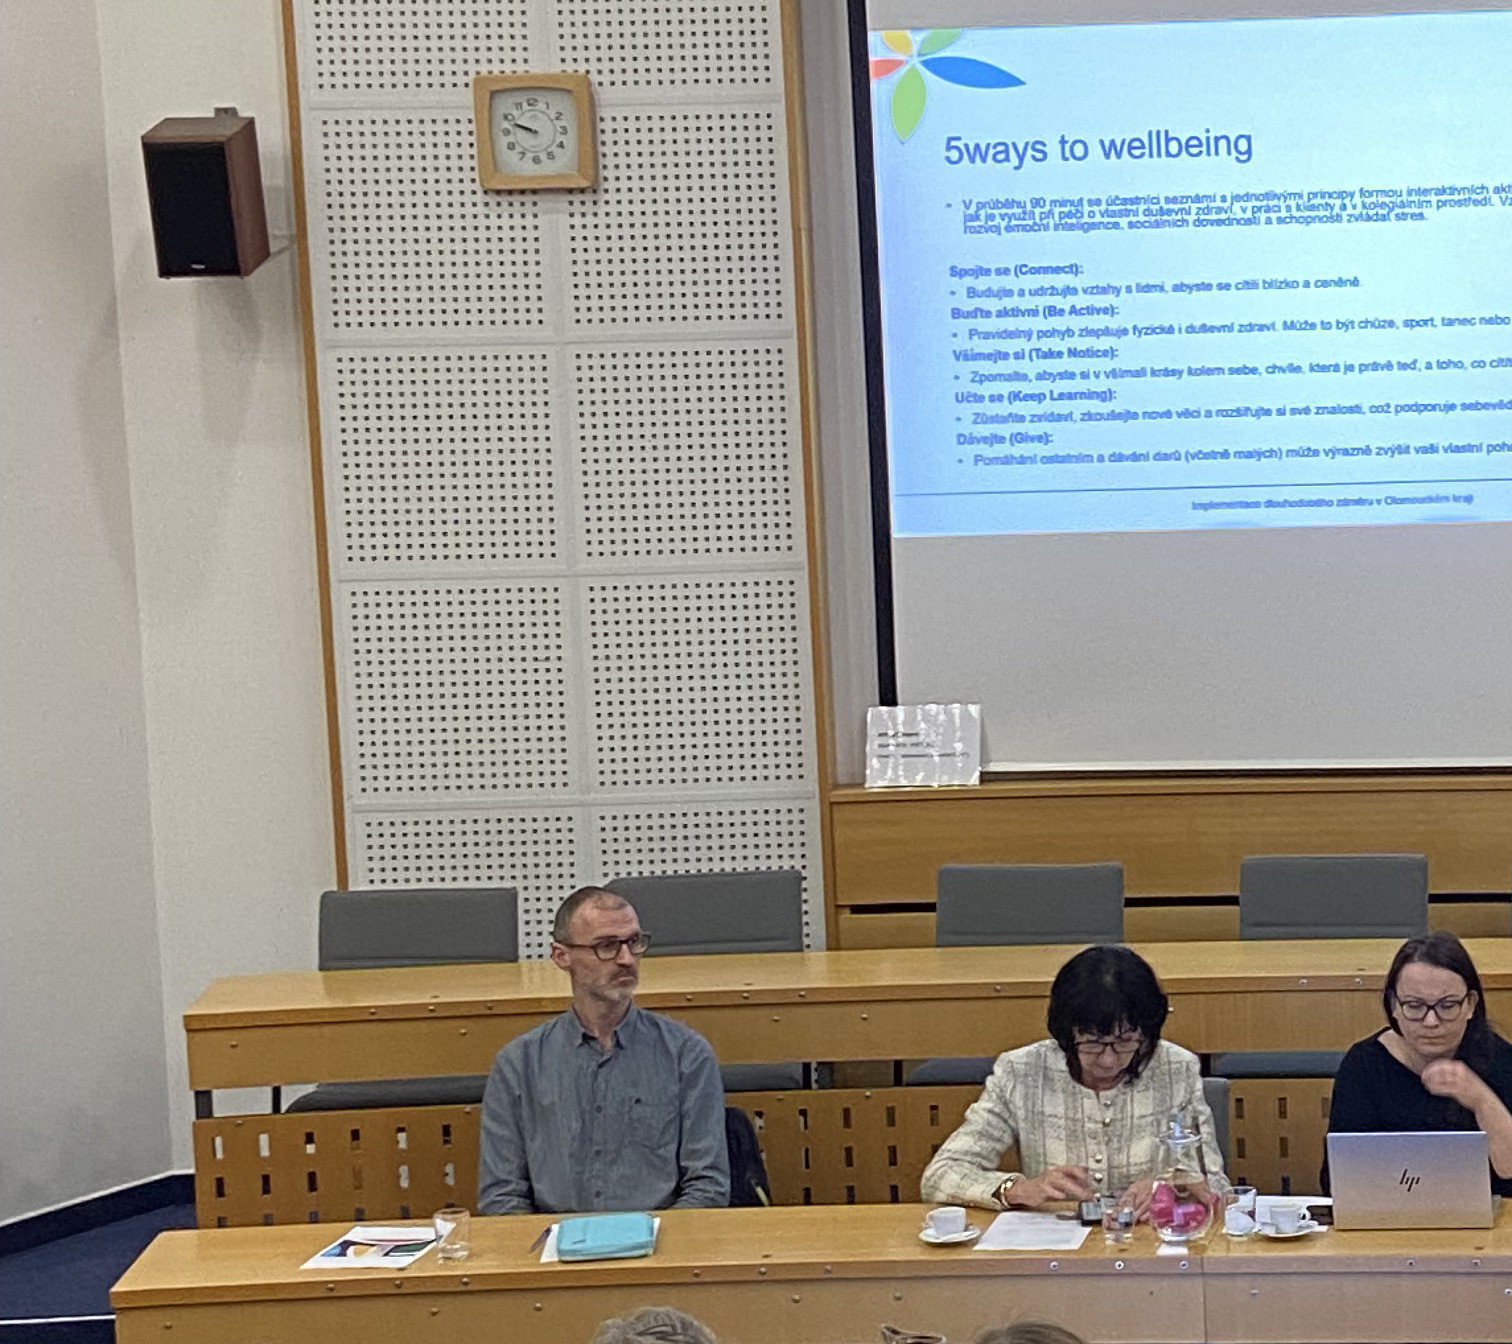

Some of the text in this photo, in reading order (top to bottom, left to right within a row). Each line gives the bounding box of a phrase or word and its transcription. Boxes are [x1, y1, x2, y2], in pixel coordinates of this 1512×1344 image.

[944, 128, 1253, 171] 5ways to wellbeing
[1030, 197, 1044, 207] 90
[1049, 196, 1084, 207] minut
[1087, 198, 1101, 206] se
[1307, 188, 1355, 202] principy
[1359, 187, 1402, 198] formou
[964, 210, 980, 224] jak
[984, 210, 996, 223] je
[1295, 200, 1335, 214] klienty
[964, 221, 1001, 235] rozvoj
[1394, 209, 1428, 220] stres.
[949, 263, 1084, 279] Spojte se (Connect):
[966, 287, 1014, 300] Budujte
[1081, 283, 1122, 297] vztahy
[1136, 282, 1168, 294] lidmi,
[1171, 281, 1212, 294] abyste
[1216, 283, 1231, 291] se
[1043, 305, 1065, 319] (Be
[1068, 304, 1119, 318] Active):
[1036, 327, 1075, 341] pohyb
[1320, 319, 1332, 330] to
[1441, 316, 1476, 327] tanec
[1479, 315, 1510, 325] nebo
[1013, 349, 1025, 359] si
[1029, 348, 1064, 362] (Take
[1067, 346, 1118, 361] Notice):
[970, 370, 1032, 385] Zpomalte,
[1035, 369, 1076, 383] abyste
[1080, 369, 1090, 379] si
[1187, 365, 1224, 376] kolem
[1227, 364, 1262, 376] sebe,
[1343, 361, 1355, 375] je
[1436, 359, 1468, 371] toho,
[1470, 361, 1486, 369] co
[988, 394, 1004, 402] se
[1007, 391, 1046, 405] (Keep
[1049, 389, 1116, 403] Learning):
[1275, 405, 1286, 416] si
[1394, 401, 1456, 415] podporuje
[1009, 432, 1054, 446] (Give):
[1399, 1168, 1420, 1192] hp
